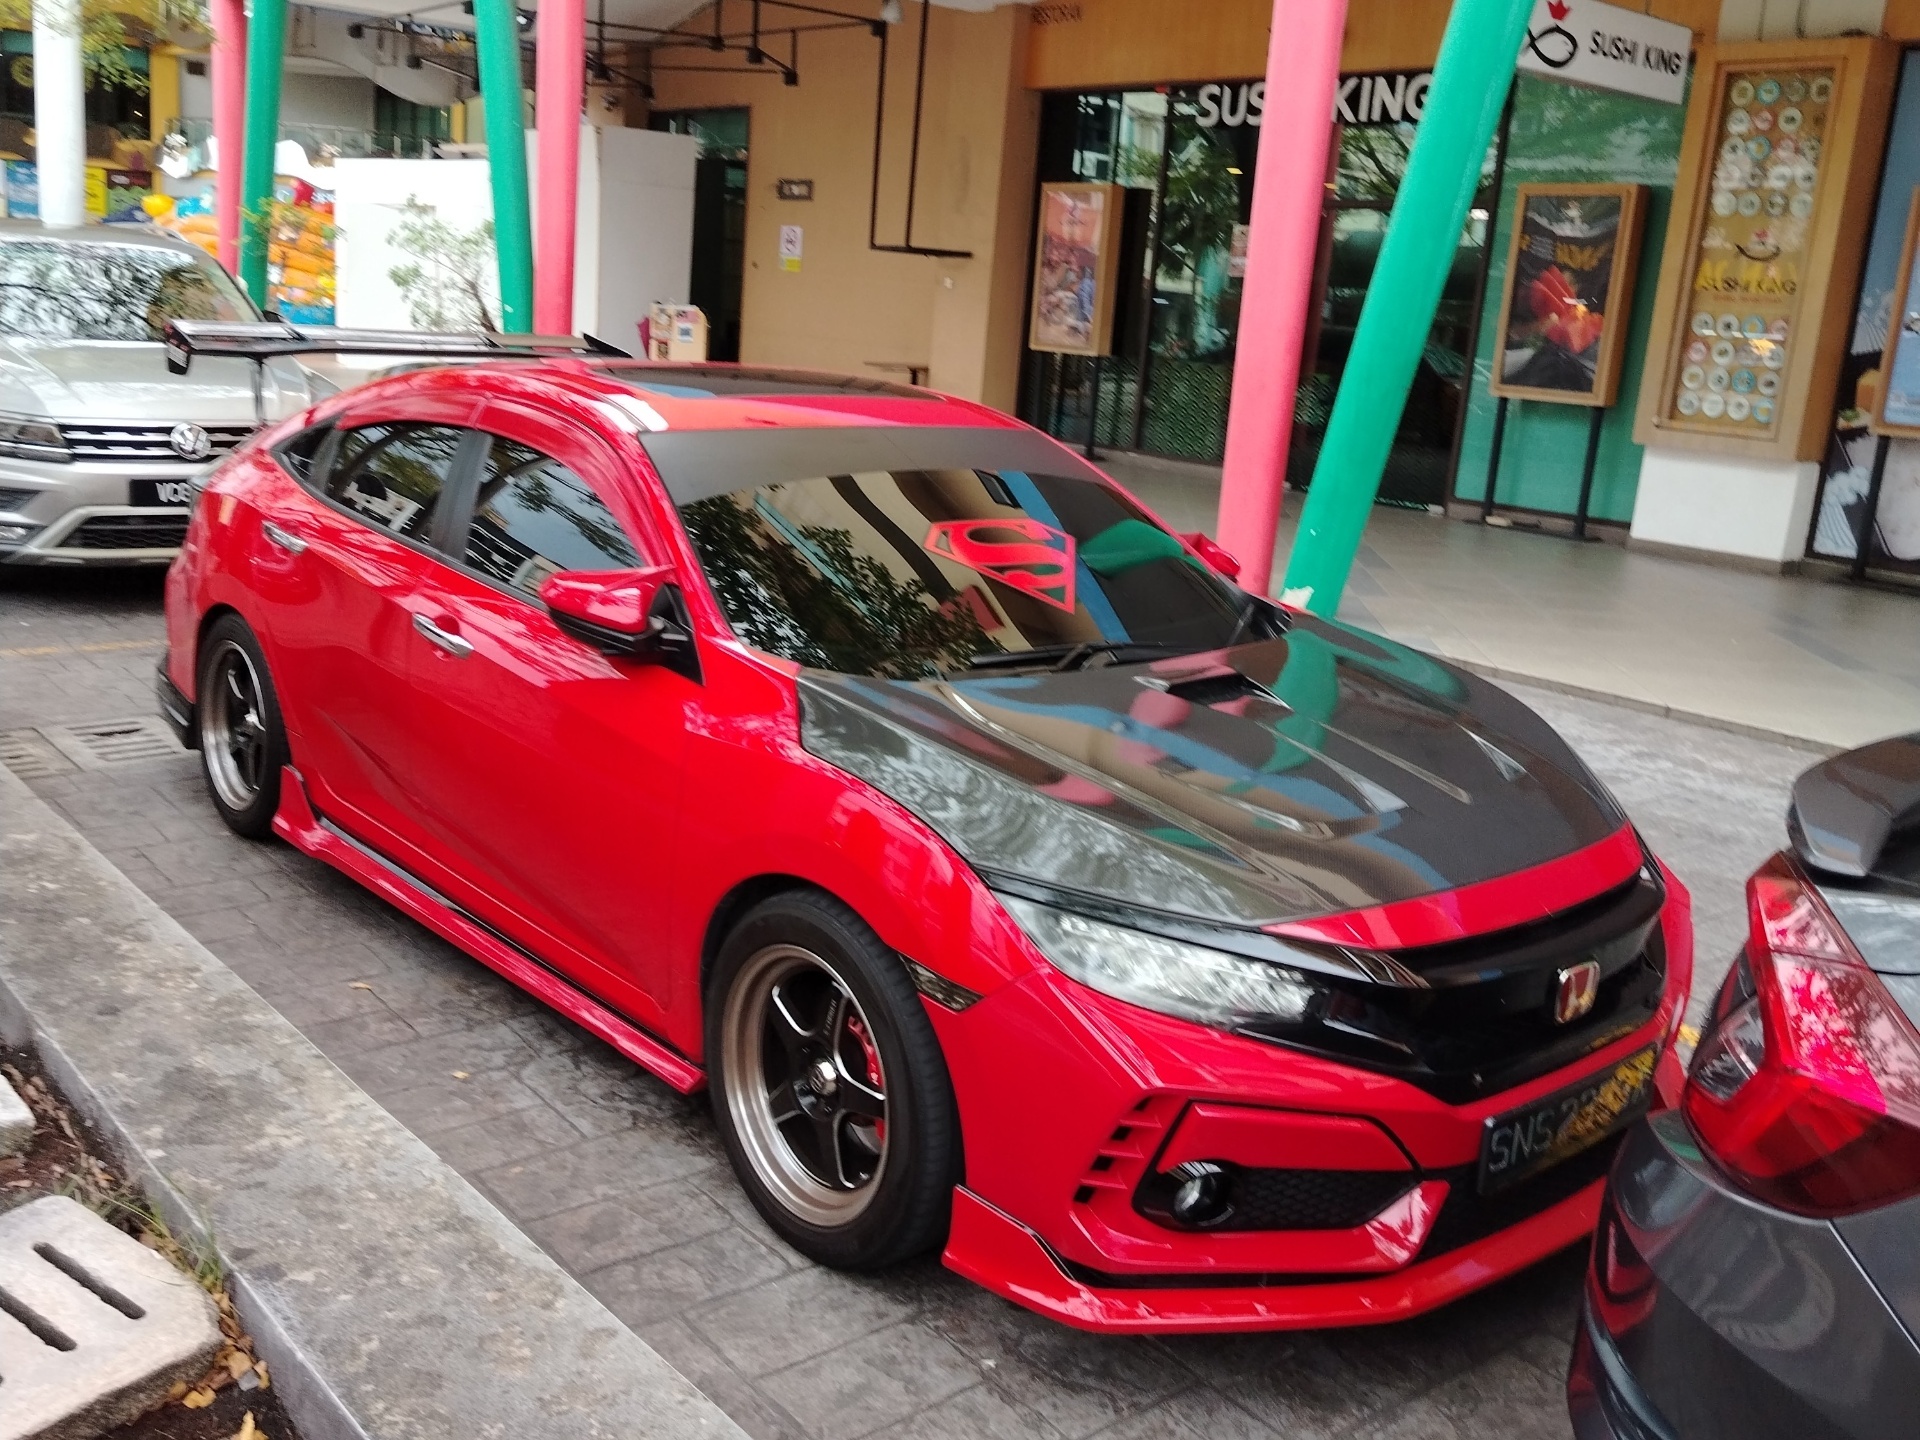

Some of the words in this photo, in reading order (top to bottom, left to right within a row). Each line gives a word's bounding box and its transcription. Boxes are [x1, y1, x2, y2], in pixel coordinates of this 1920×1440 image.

[1589, 30, 1638, 65] SUSHI
[1642, 43, 1684, 76] KING
[1196, 82, 1266, 128] SUS
[1331, 73, 1435, 124] KING
